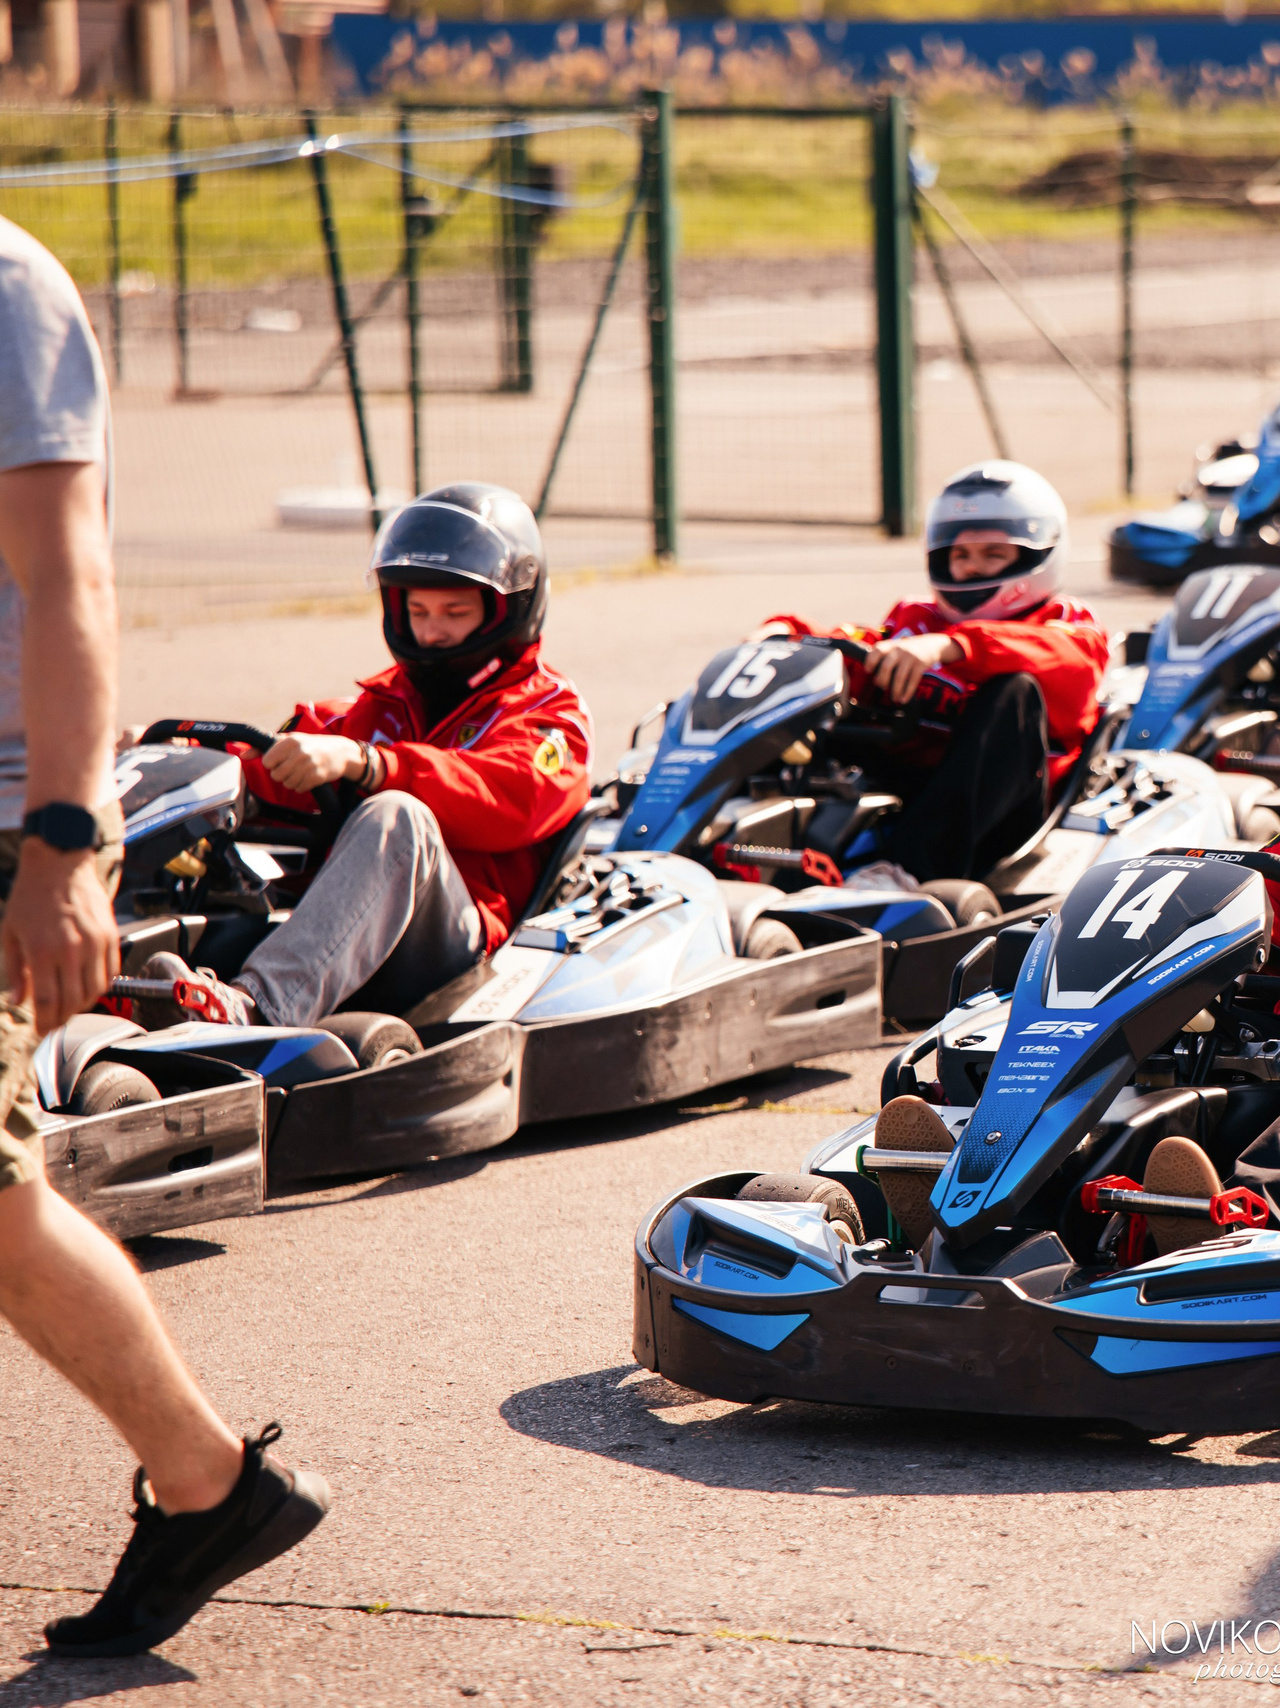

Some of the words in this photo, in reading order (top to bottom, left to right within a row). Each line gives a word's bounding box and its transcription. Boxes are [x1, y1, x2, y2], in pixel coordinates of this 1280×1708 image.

[706, 645, 794, 699] 15
[1146, 859, 1205, 869] SODI
[1203, 852, 1245, 862] SODI
[1077, 869, 1190, 940] 14
[1148, 944, 1216, 986] SODIKART.COM
[1015, 1020, 1099, 1035] SR
[714, 1260, 760, 1280] SODIKART.COM
[1181, 1293, 1267, 1309] SODIKART.COM
